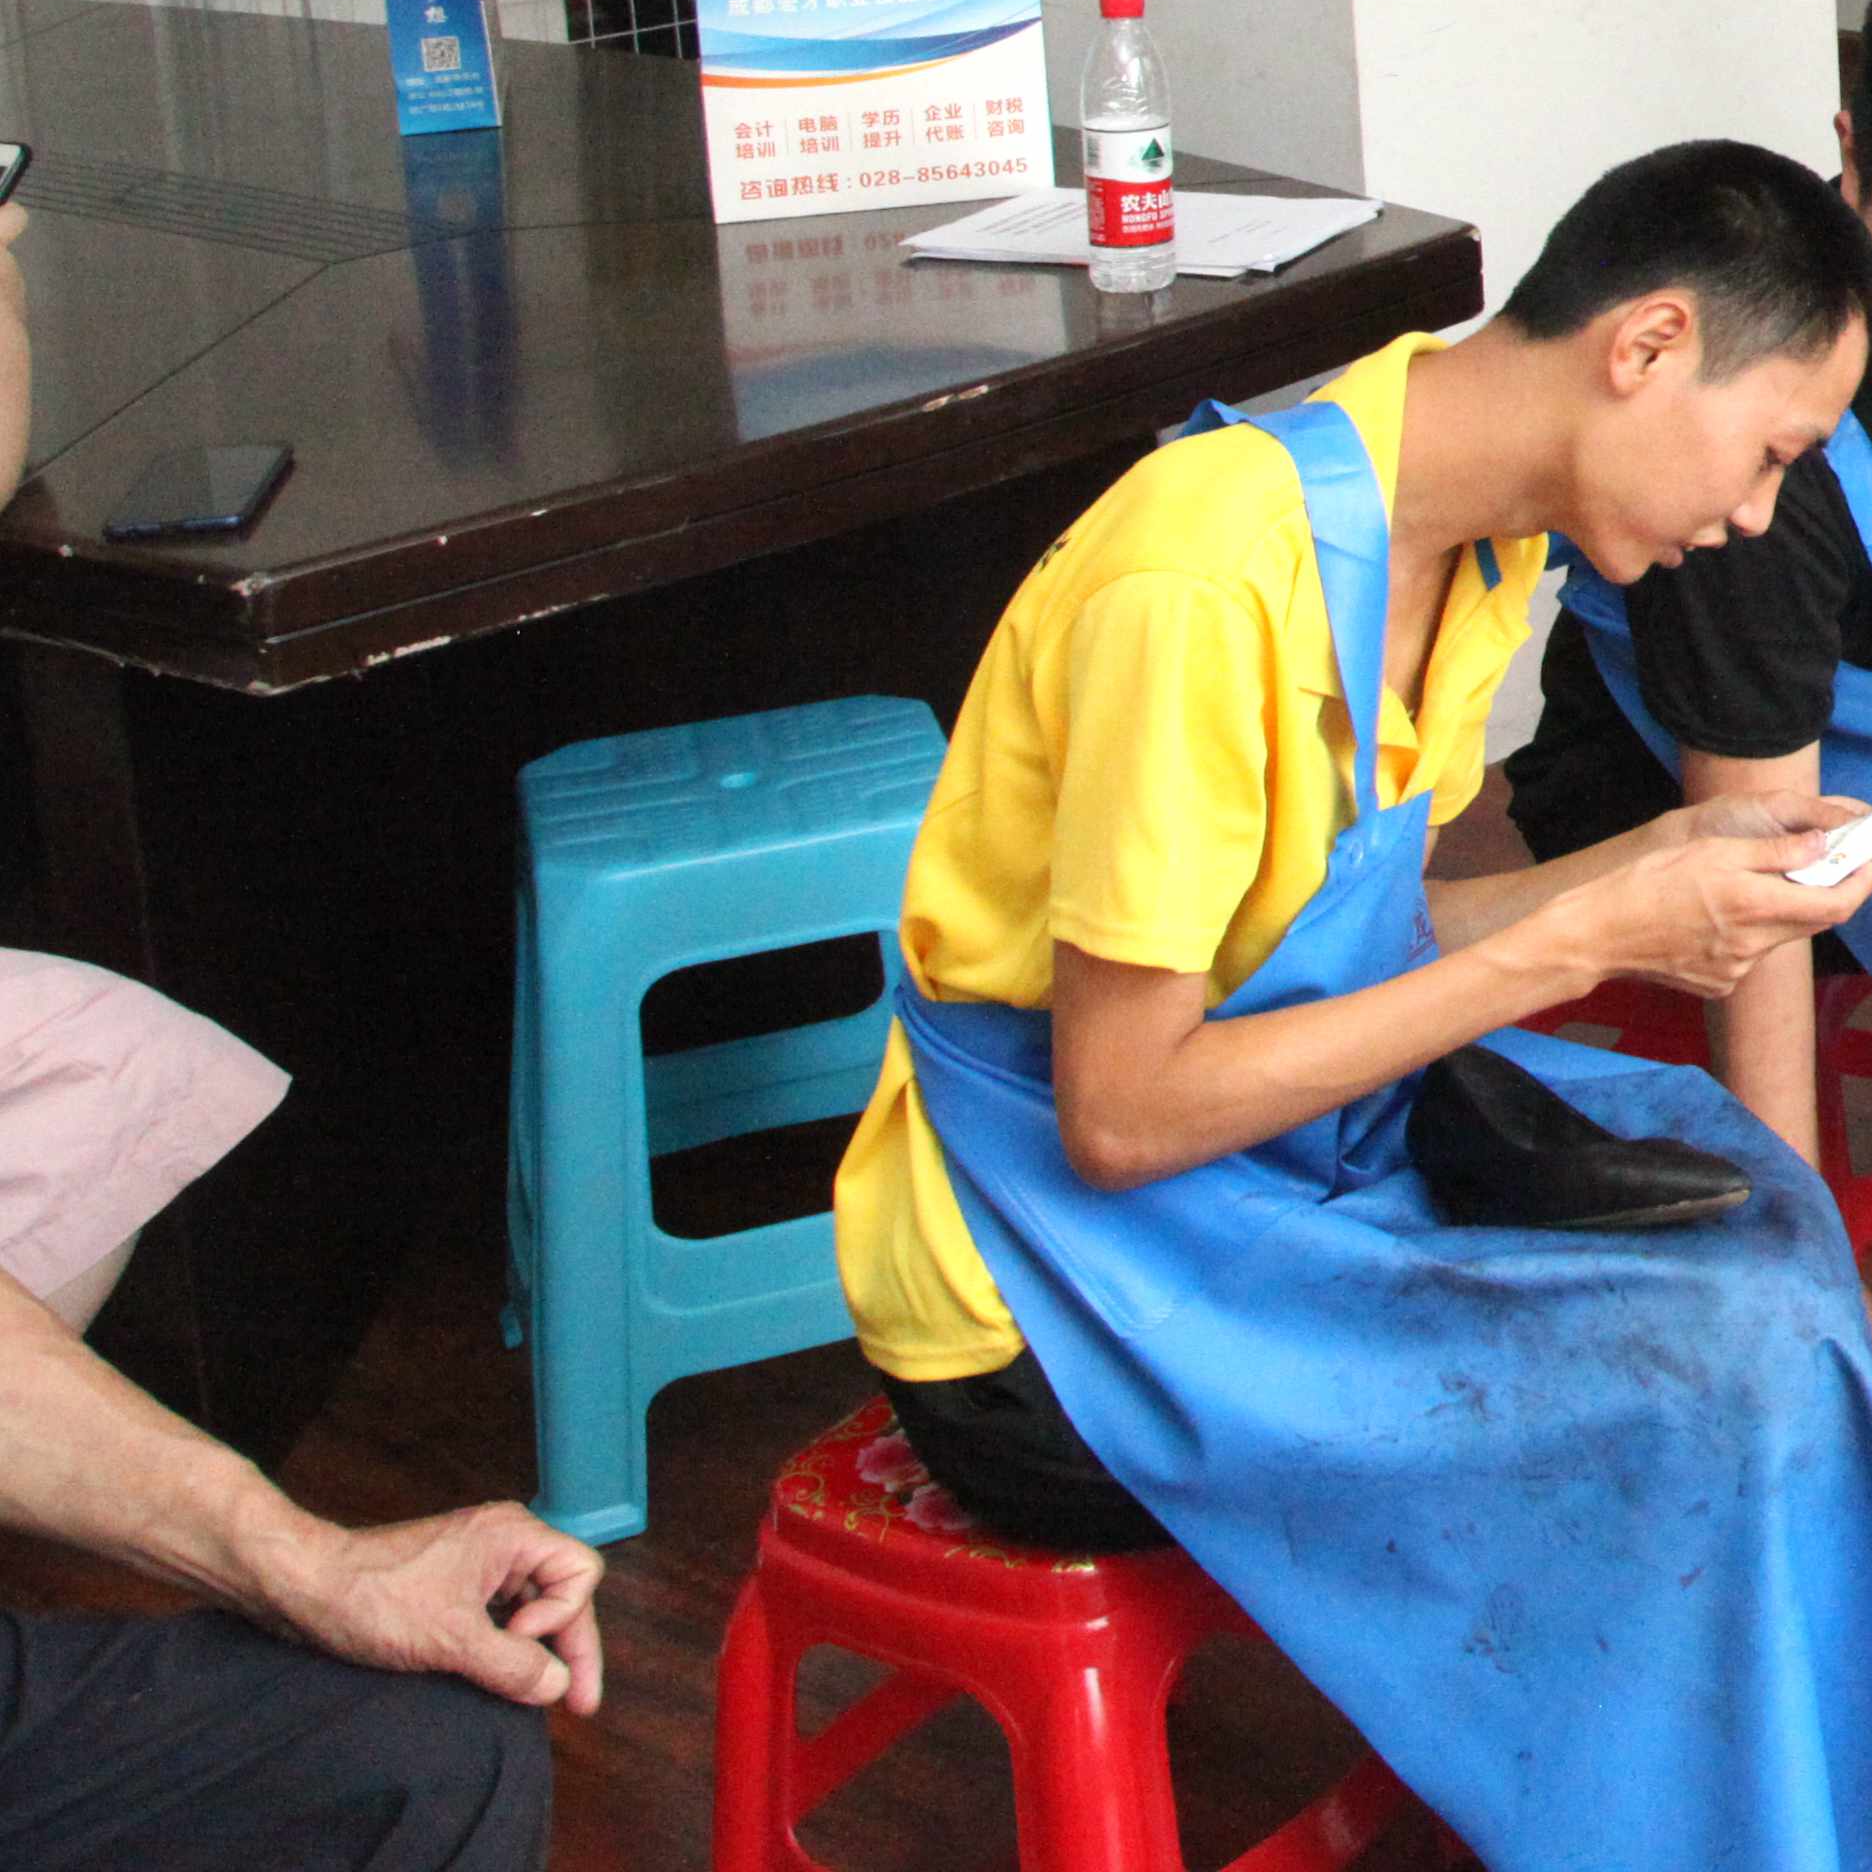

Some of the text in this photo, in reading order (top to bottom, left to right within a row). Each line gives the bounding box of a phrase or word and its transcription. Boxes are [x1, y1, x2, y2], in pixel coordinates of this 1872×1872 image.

[734, 96, 1024, 140] 会计 电脑 学历 企业 财税
[735, 118, 1026, 160] 培训 培训 提升 代账 咨询
